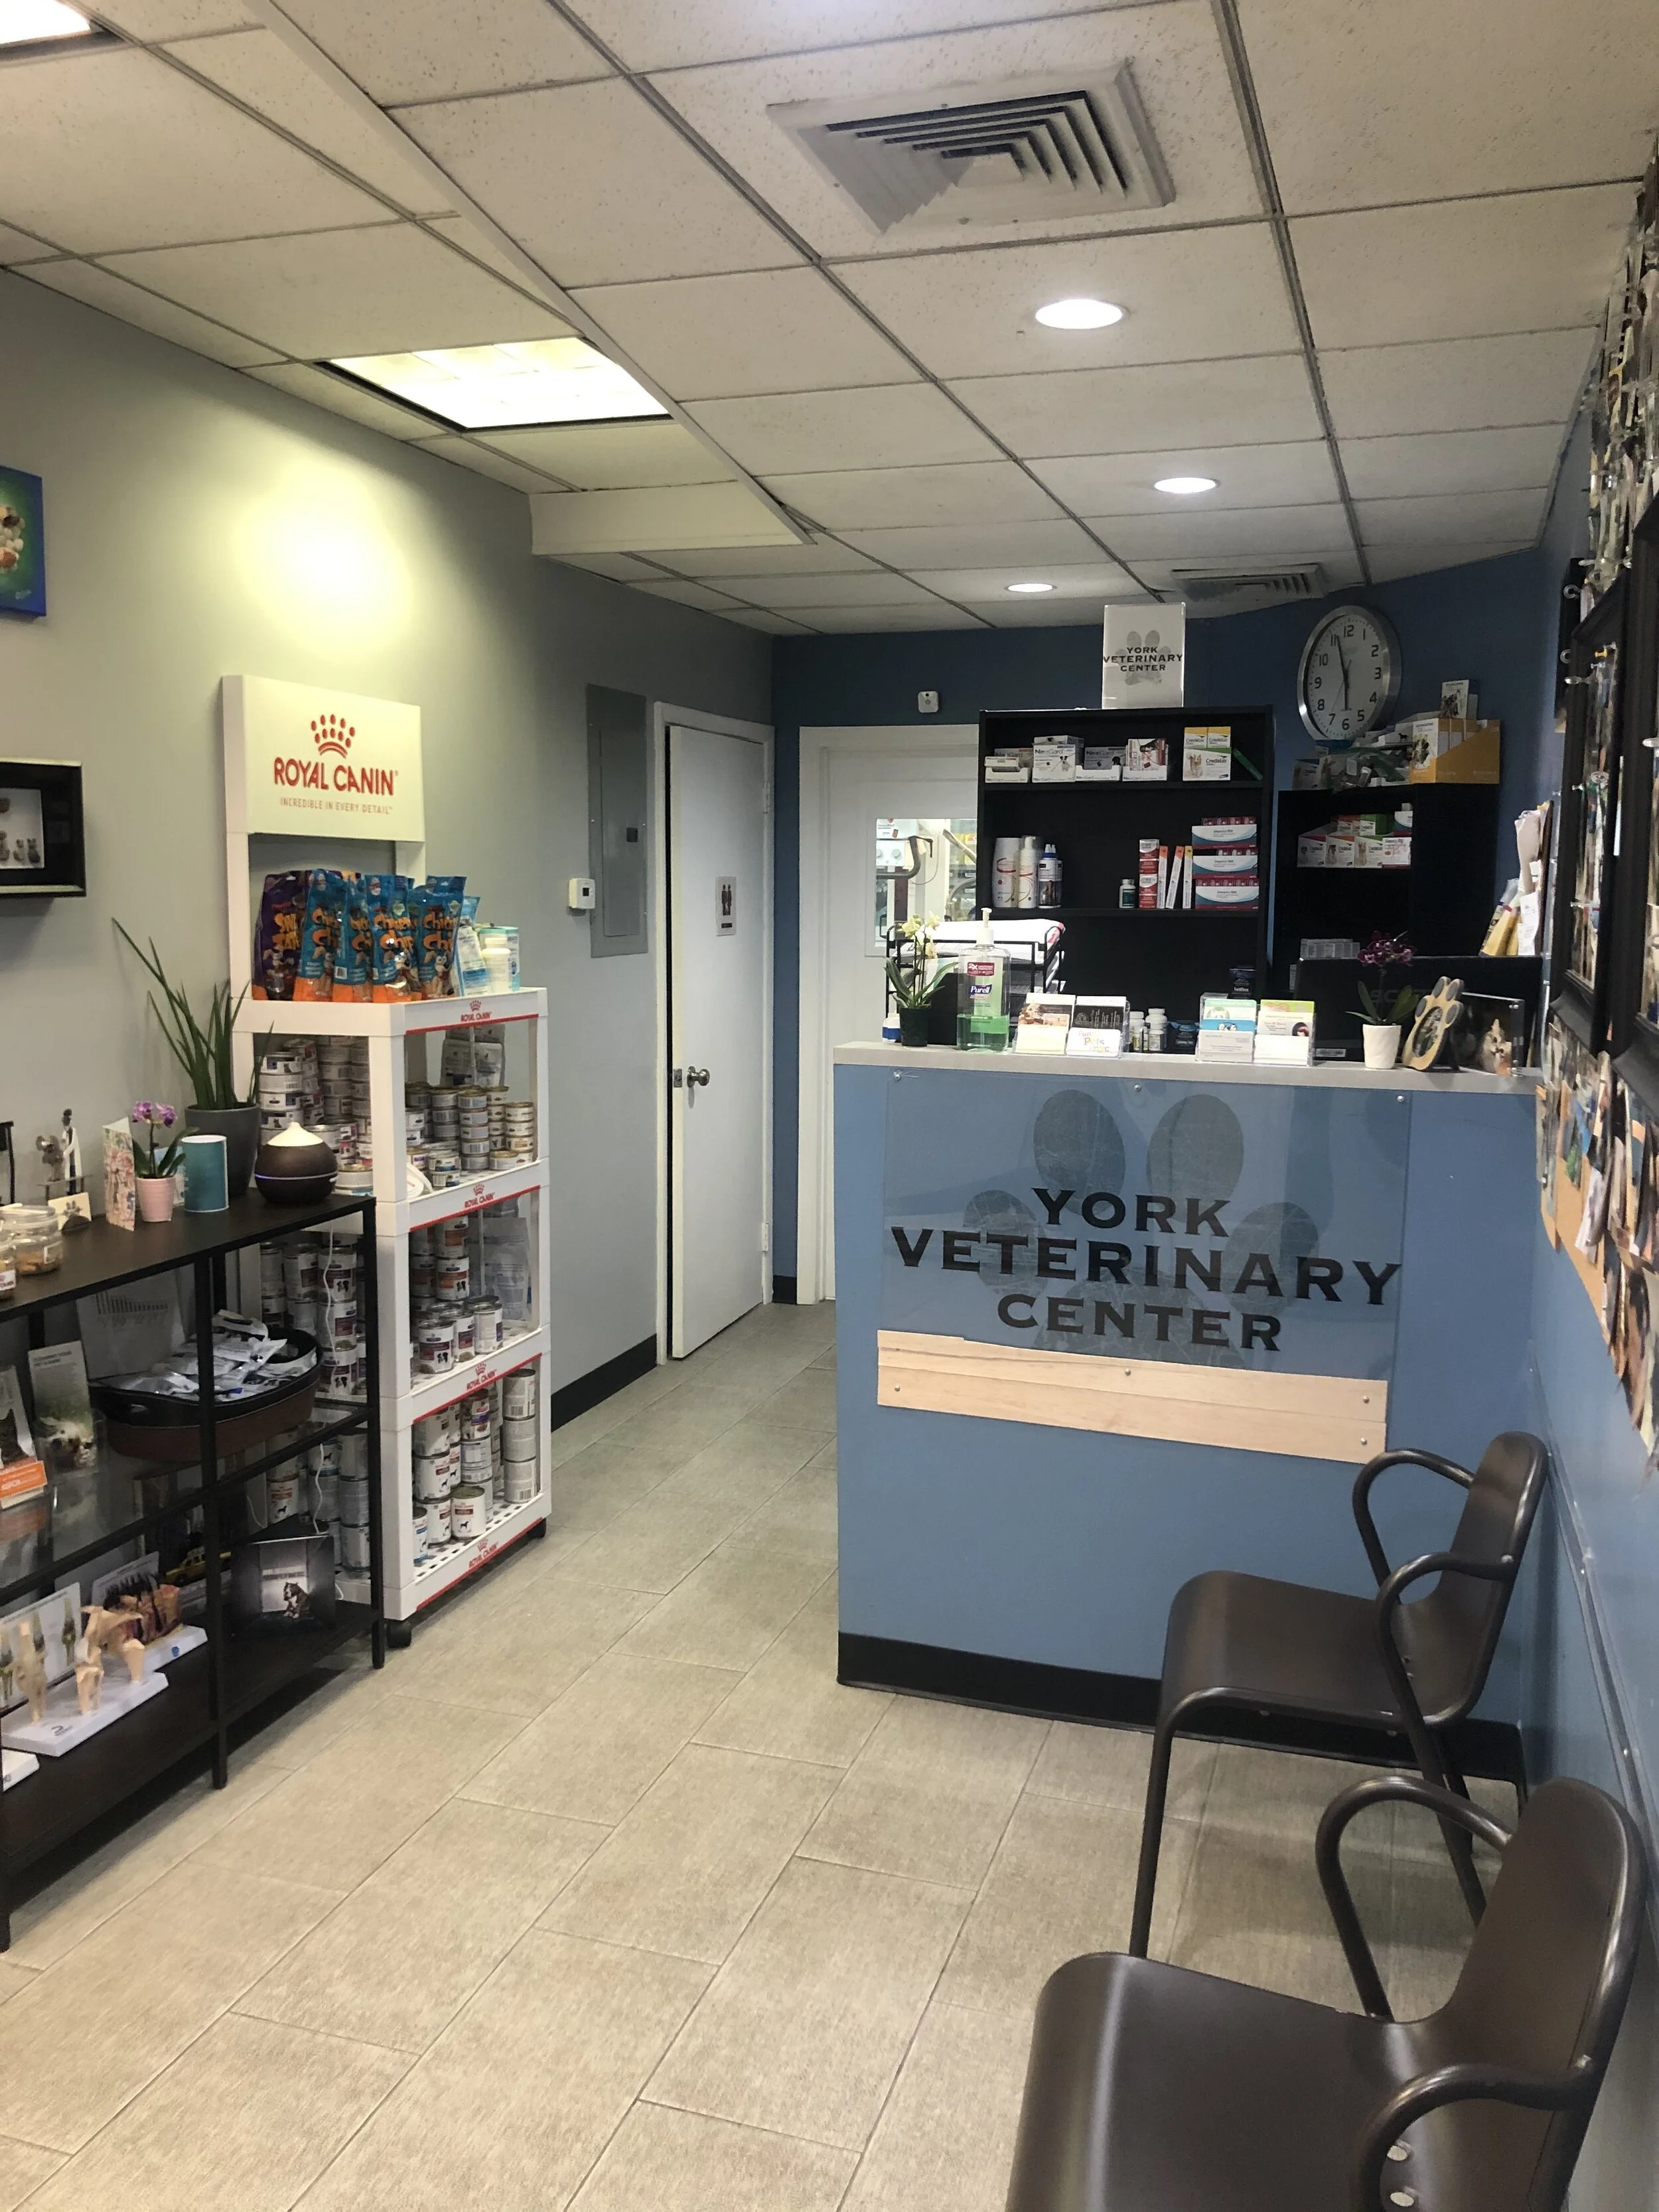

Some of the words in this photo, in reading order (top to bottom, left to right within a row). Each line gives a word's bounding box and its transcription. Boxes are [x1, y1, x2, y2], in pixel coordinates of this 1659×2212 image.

[1343, 625, 1354, 638] 12
[1330, 634, 1336, 647] 11
[1371, 644, 1379, 658] 2
[1103, 654, 1183, 663] VETERINARY
[1319, 653, 1329, 666] 10
[1374, 667, 1382, 680] 3
[1314, 677, 1322, 689] 9
[1317, 698, 1325, 711] 8
[1369, 692, 1377, 704] 4
[1328, 713, 1336, 725] 7
[1357, 709, 1365, 722] 5
[1342, 718, 1350, 730] 6
[273, 757, 329, 790] ROYAL
[334, 764, 394, 796] CANIN
[280, 796, 323, 810] INCREDIBLE
[326, 800, 332, 810] IN
[335, 802, 360, 812] EVERY
[362, 804, 390, 815] DETAIL
[970, 985, 991, 994] Purell
[1031, 1187, 1231, 1238] YORK
[891, 1226, 1402, 1305] VETERINARY
[997, 1292, 1282, 1352] CENTER
